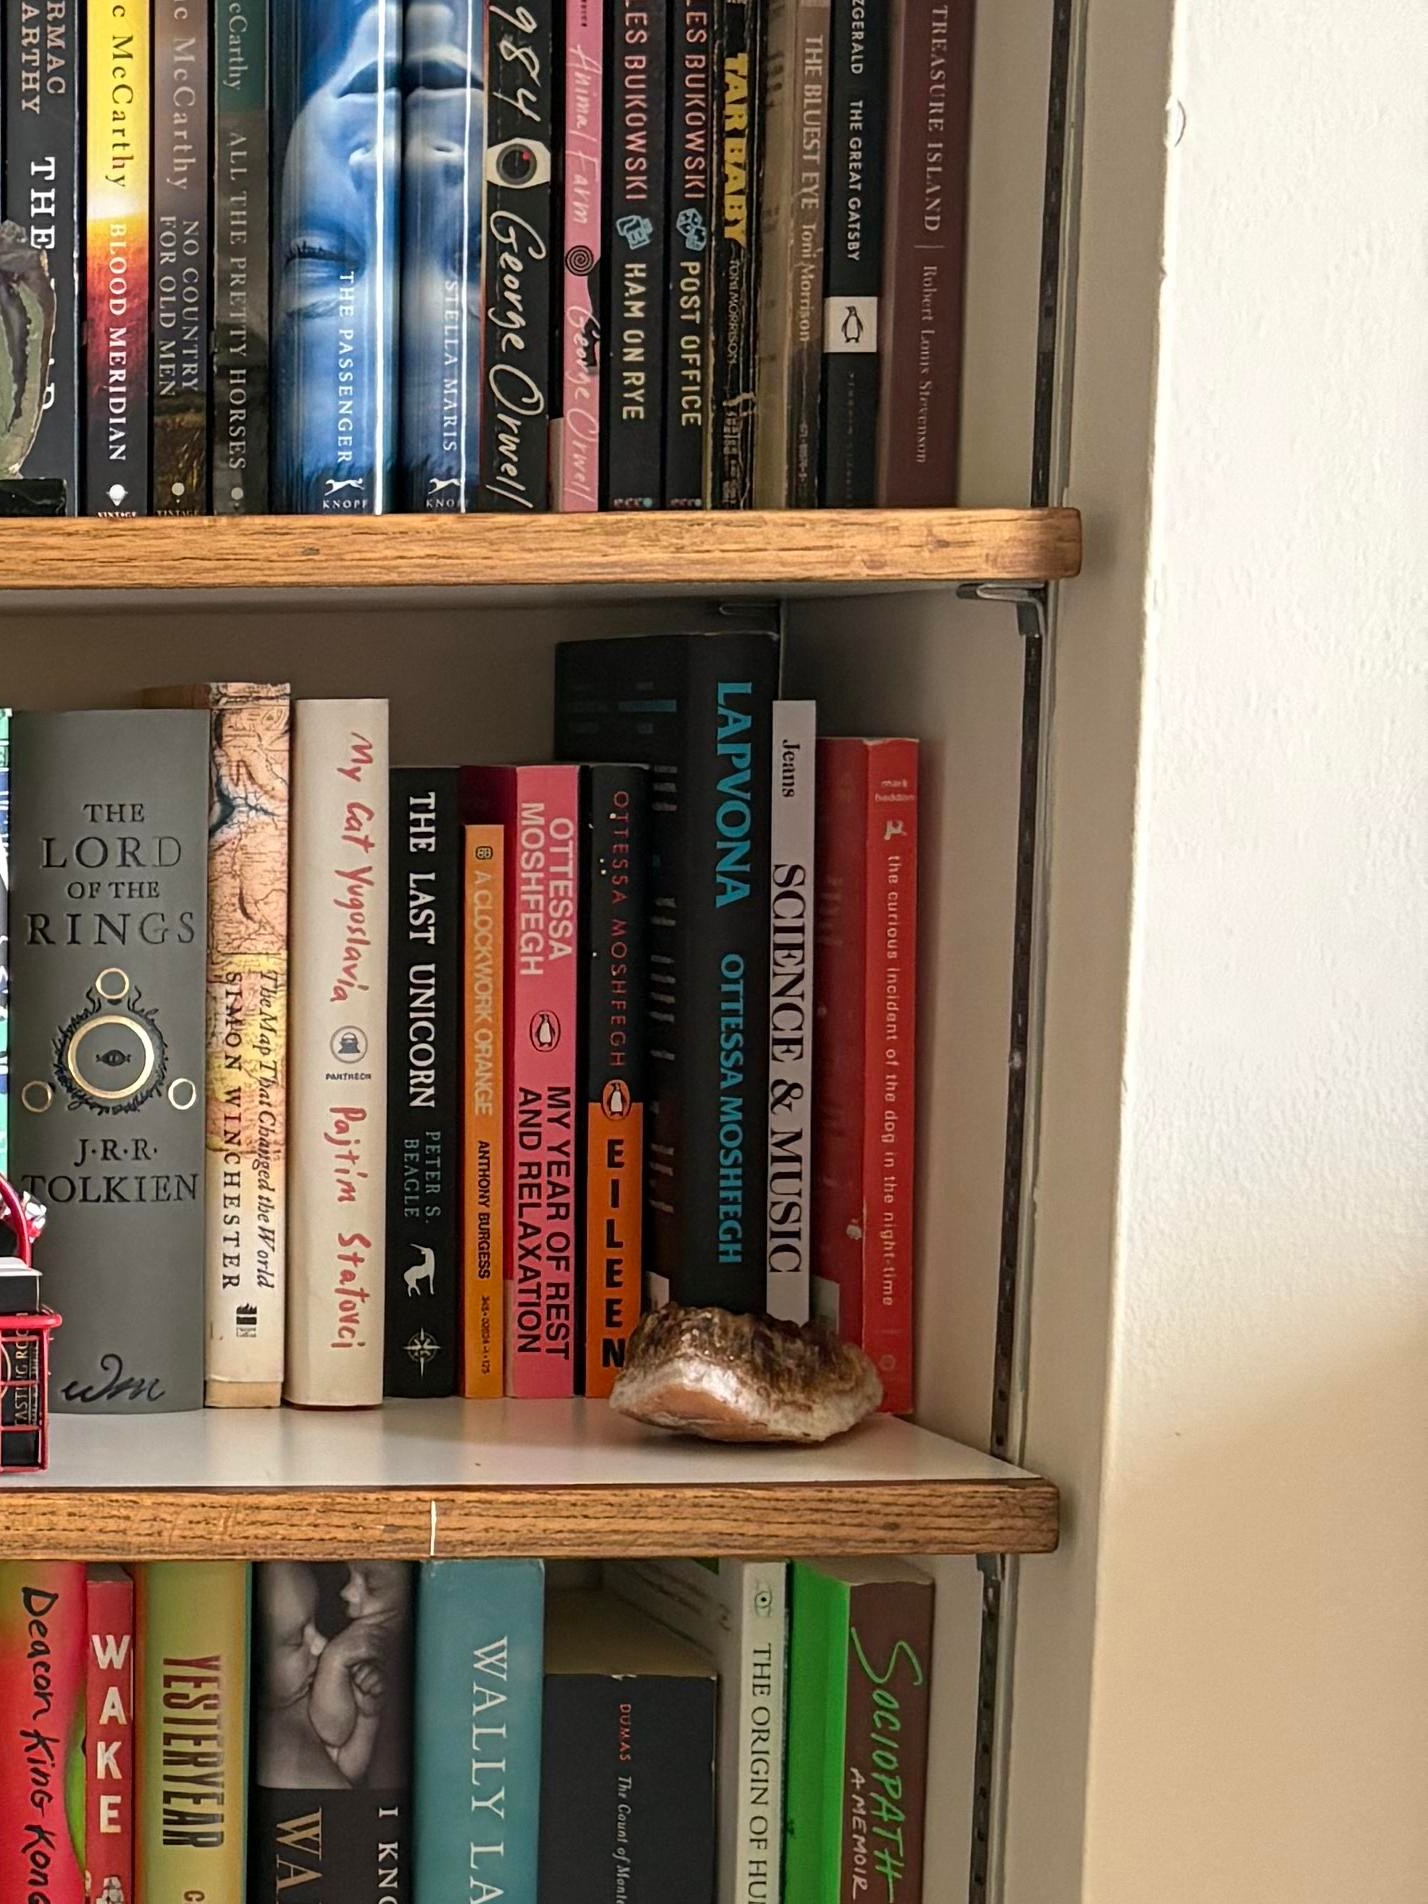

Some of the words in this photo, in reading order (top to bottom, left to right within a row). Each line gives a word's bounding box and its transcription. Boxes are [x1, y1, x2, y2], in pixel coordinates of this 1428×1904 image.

[928, 5, 949, 132] TREASURE
[624, 55, 648, 202] BUKOWSKI
[850, 100, 864, 129] THE
[849, 135, 864, 190] GREAT
[924, 137, 944, 233] ISLAND
[848, 196, 864, 262] GATSBY
[106, 223, 128, 319] BLOOD
[623, 263, 646, 320] HAM
[623, 332, 645, 367] ON
[106, 326, 127, 462] MERIDIAN
[622, 376, 645, 421] RYE
[713, 681, 753, 909] LAPVONA
[780, 738, 797, 799] Jeans
[84, 803, 145, 824] THE
[41, 836, 183, 871] LORD
[67, 881, 100, 900] OF
[107, 879, 160, 899] THE
[25, 912, 197, 947] RINGS
[770, 863, 808, 1064] SCIENCE
[770, 1080, 805, 1115] &
[767, 1129, 804, 1273] MUSIC
[162, 1654, 225, 1849] YESTERYEAR
[618, 1703, 633, 1762] DUMAS
